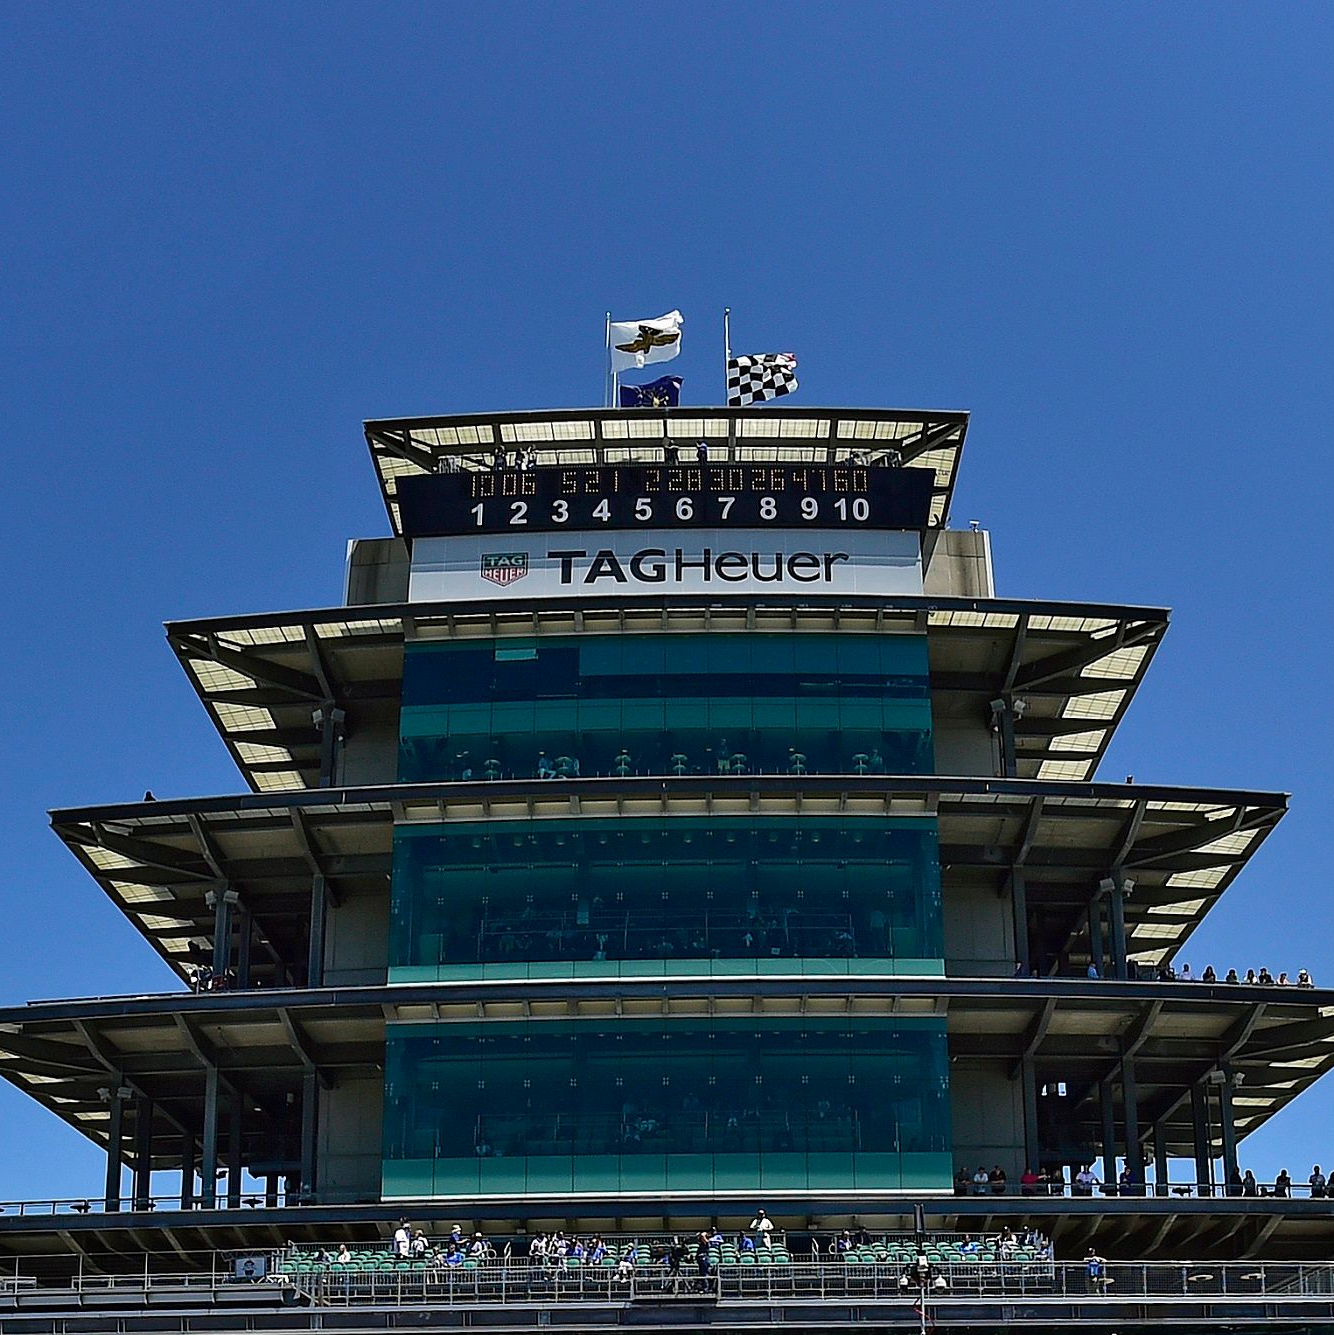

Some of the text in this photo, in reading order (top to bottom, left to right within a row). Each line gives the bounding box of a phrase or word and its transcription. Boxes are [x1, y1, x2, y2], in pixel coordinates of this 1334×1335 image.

[471, 497, 870, 526] 1 2 3 4 5 6 7 8 9 10
[486, 555, 525, 566] TAG
[484, 567, 527, 583] HEUER
